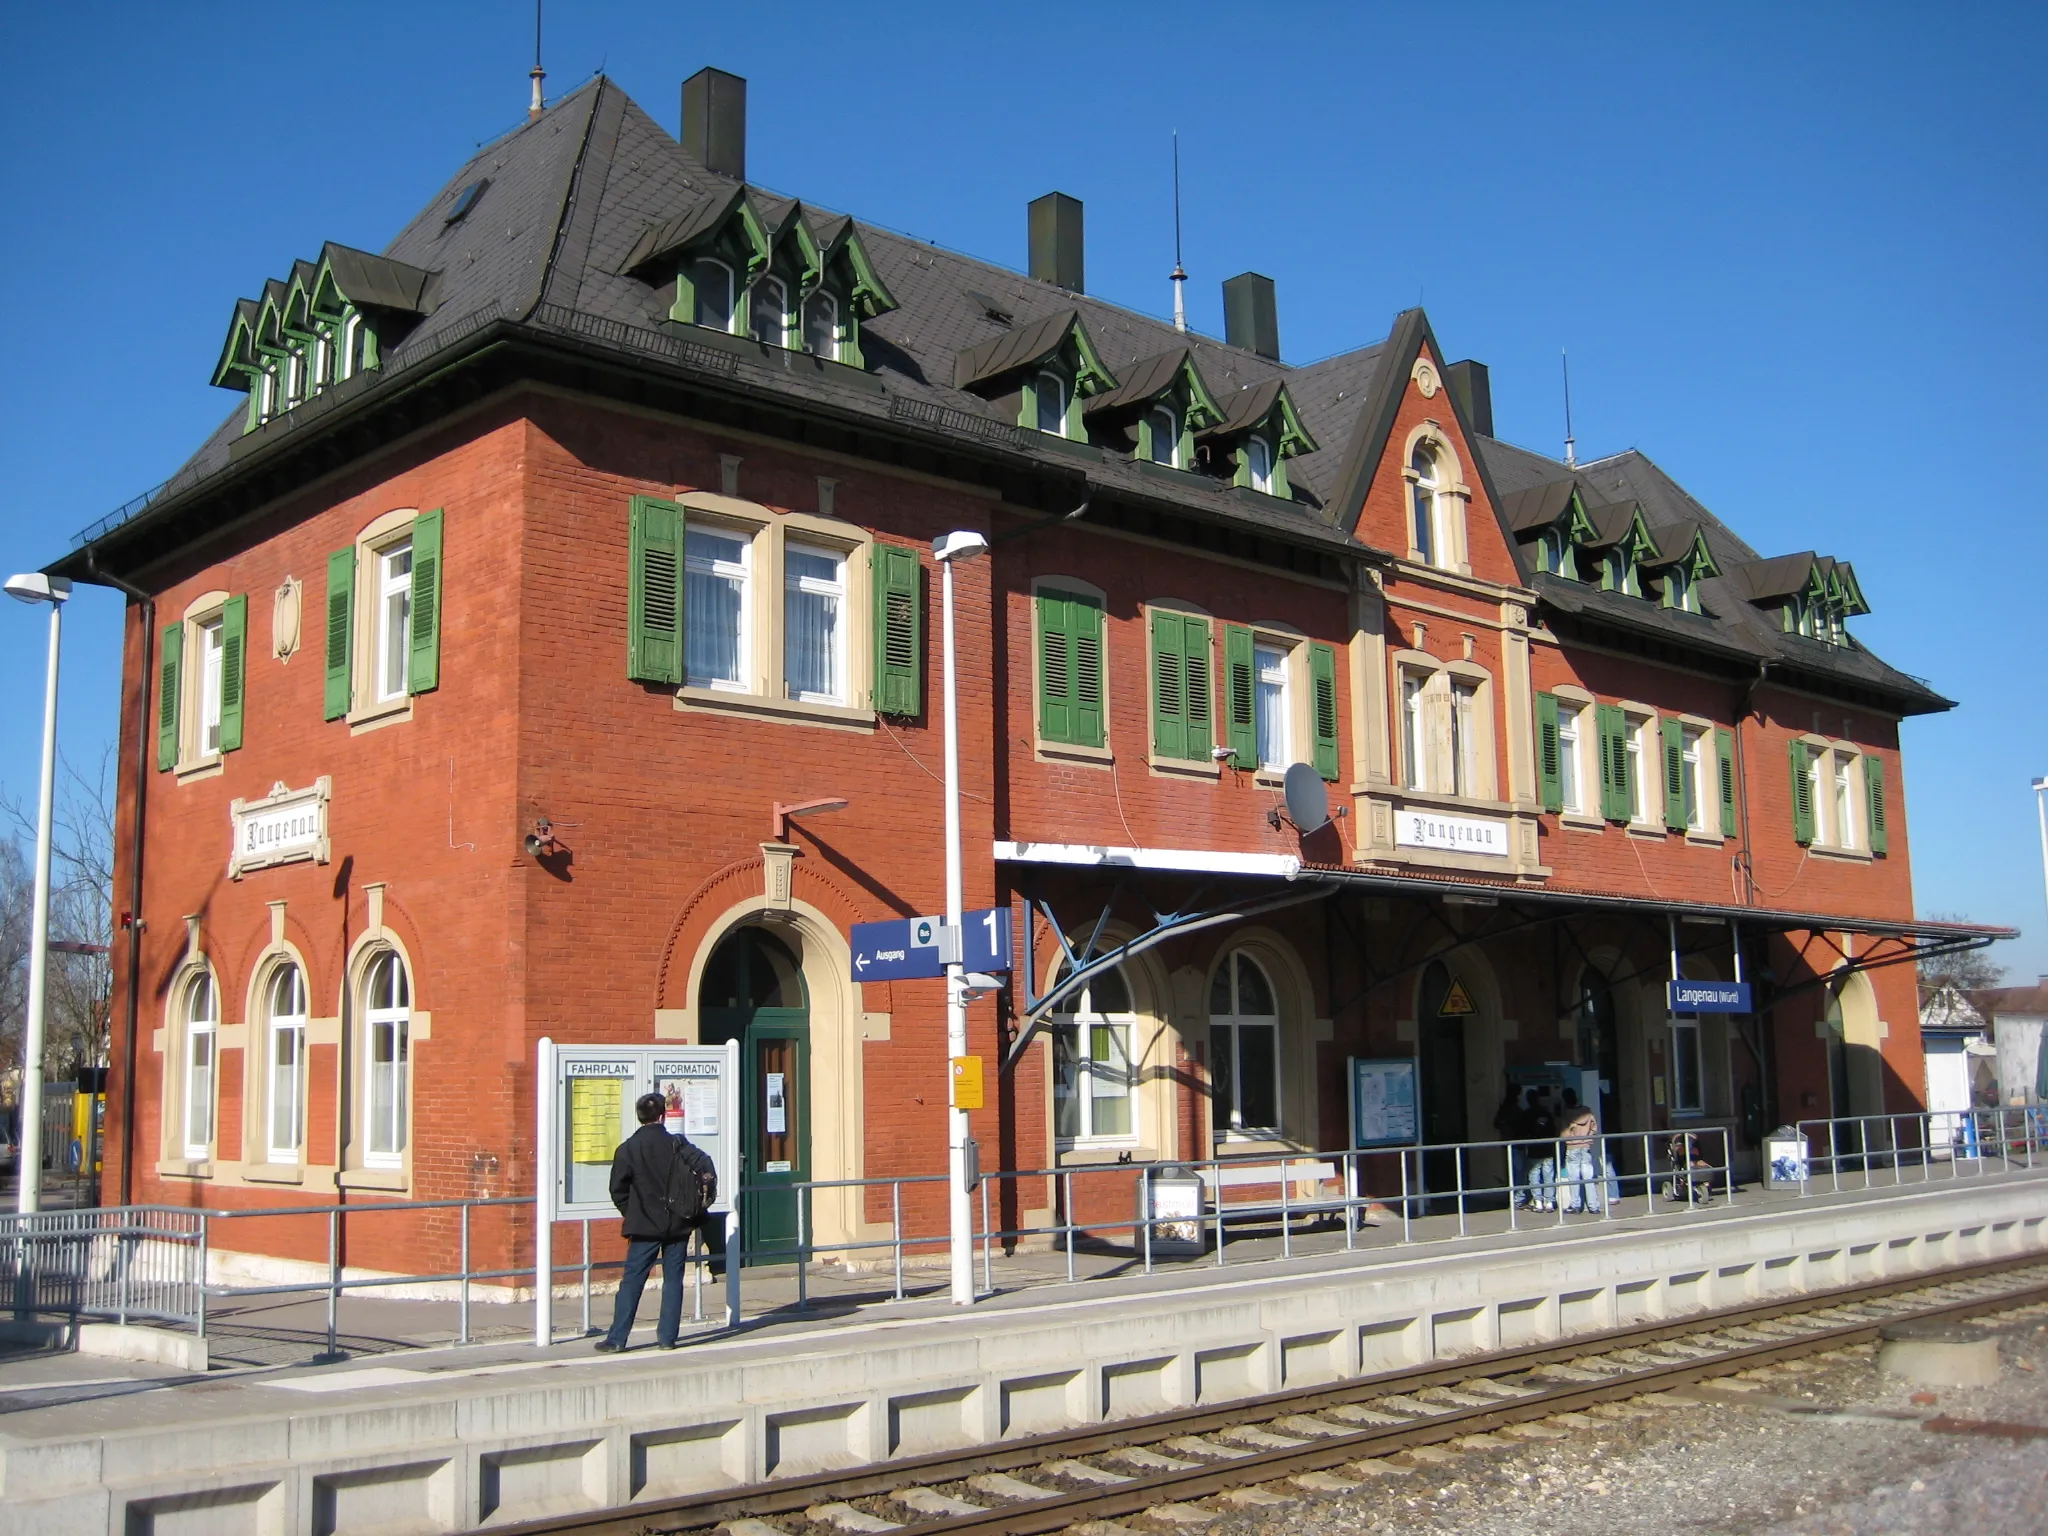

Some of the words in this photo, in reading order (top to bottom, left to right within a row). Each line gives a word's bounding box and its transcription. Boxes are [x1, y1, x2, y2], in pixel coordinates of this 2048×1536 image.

[1413, 817, 1493, 846] Langenau
[919, 929, 930, 937] Bus
[983, 909, 998, 956] 1
[876, 949, 905, 962] Ausgang
[1676, 985, 1718, 1006] Langenau
[571, 1064, 629, 1074] FAHRPLAN
[656, 1064, 718, 1074] INFORMATION
